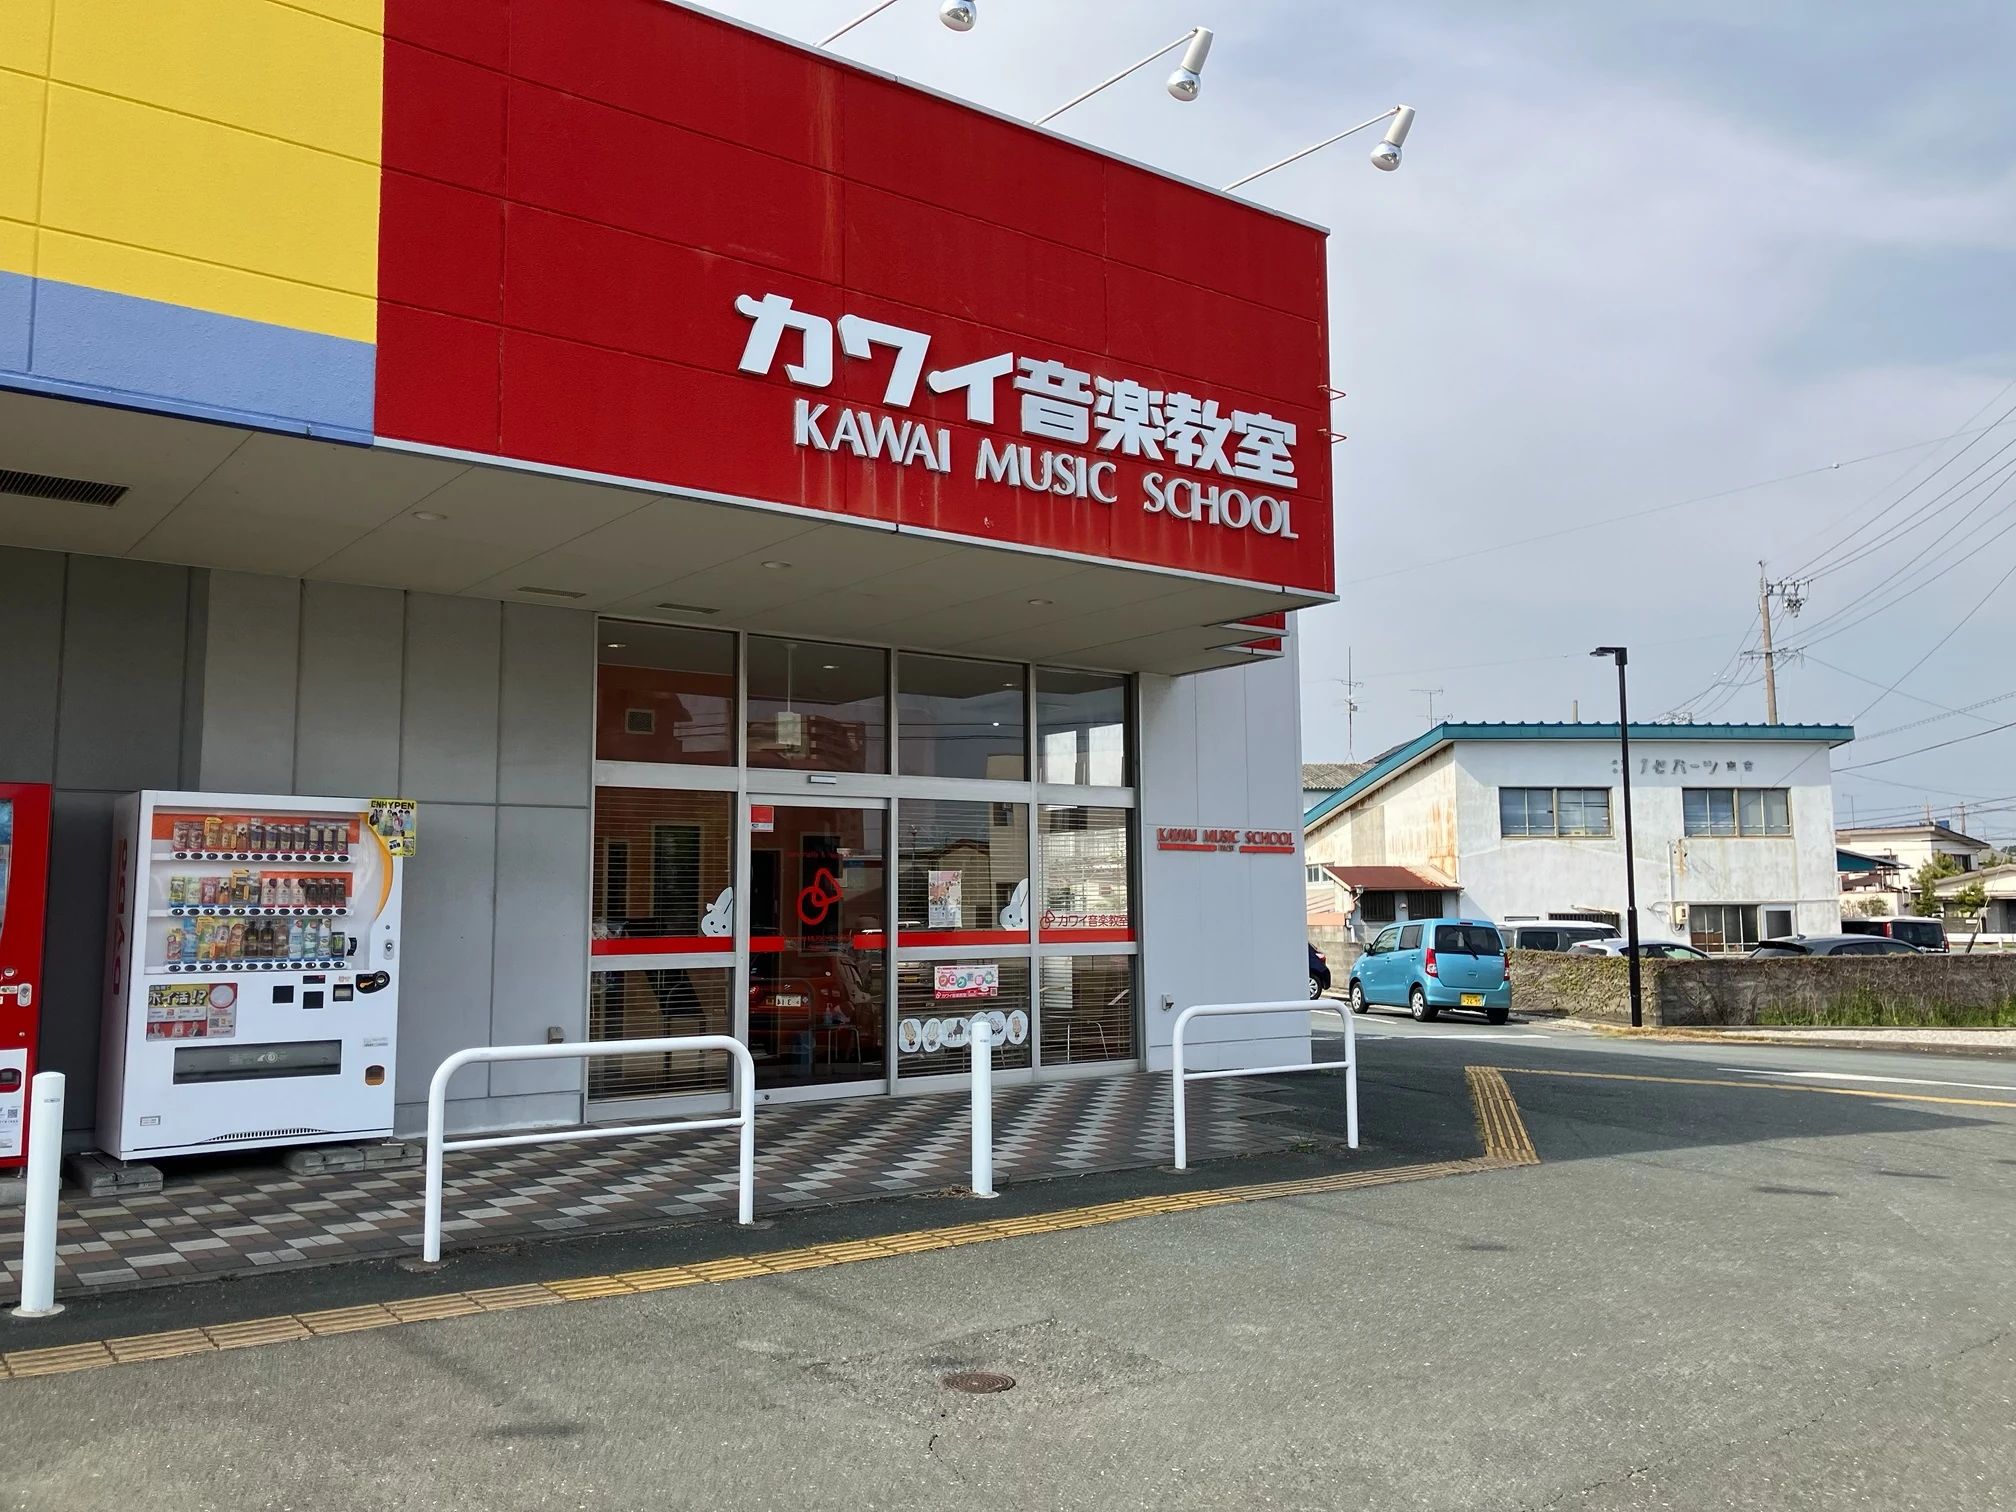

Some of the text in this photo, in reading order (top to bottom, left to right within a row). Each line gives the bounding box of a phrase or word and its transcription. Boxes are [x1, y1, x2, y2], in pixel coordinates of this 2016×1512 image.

[734, 292, 1299, 489] カワイ音楽教室
[794, 398, 1299, 539] KAWAI MUSIC SCHOOL
[371, 800, 415, 810] ENHYPEN
[1156, 828, 1295, 846] KAWAI MUSIC SCHOOL
[1057, 914, 1129, 928] カワイ音楽教室
